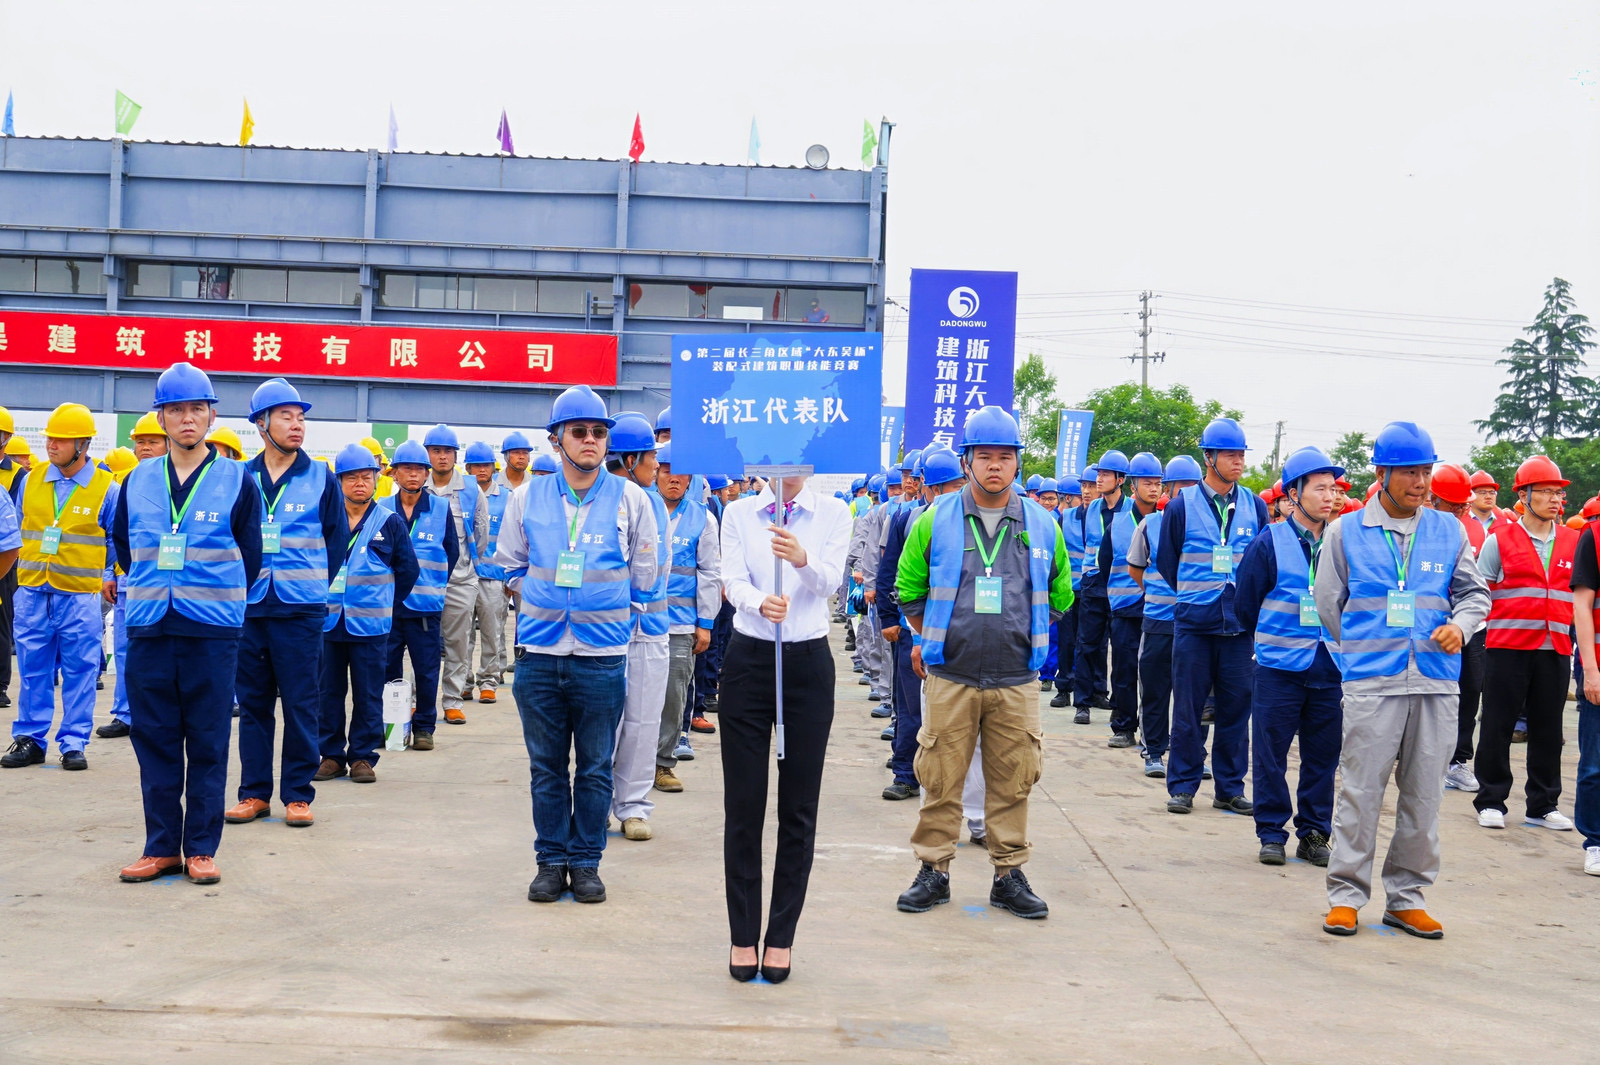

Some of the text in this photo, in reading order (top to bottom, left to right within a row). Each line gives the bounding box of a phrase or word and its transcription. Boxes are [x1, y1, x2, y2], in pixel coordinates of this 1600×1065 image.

[940, 319, 987, 328] DADONGWU
[0, 322, 554, 372] 建筑科技有限公司
[712, 360, 860, 372] 装配式建筑职业技能竞赛
[701, 396, 849, 425] 浙江代表队
[72, 505, 91, 516] 江苏
[284, 503, 306, 513] 浙江
[194, 510, 219, 523] 浙江
[417, 531, 434, 541] 浙江
[582, 532, 604, 544] 浙江
[1236, 527, 1252, 537] 浙江
[672, 535, 690, 547] 浙江
[1421, 560, 1445, 573] 浙江
[1557, 558, 1572, 570] 上海
